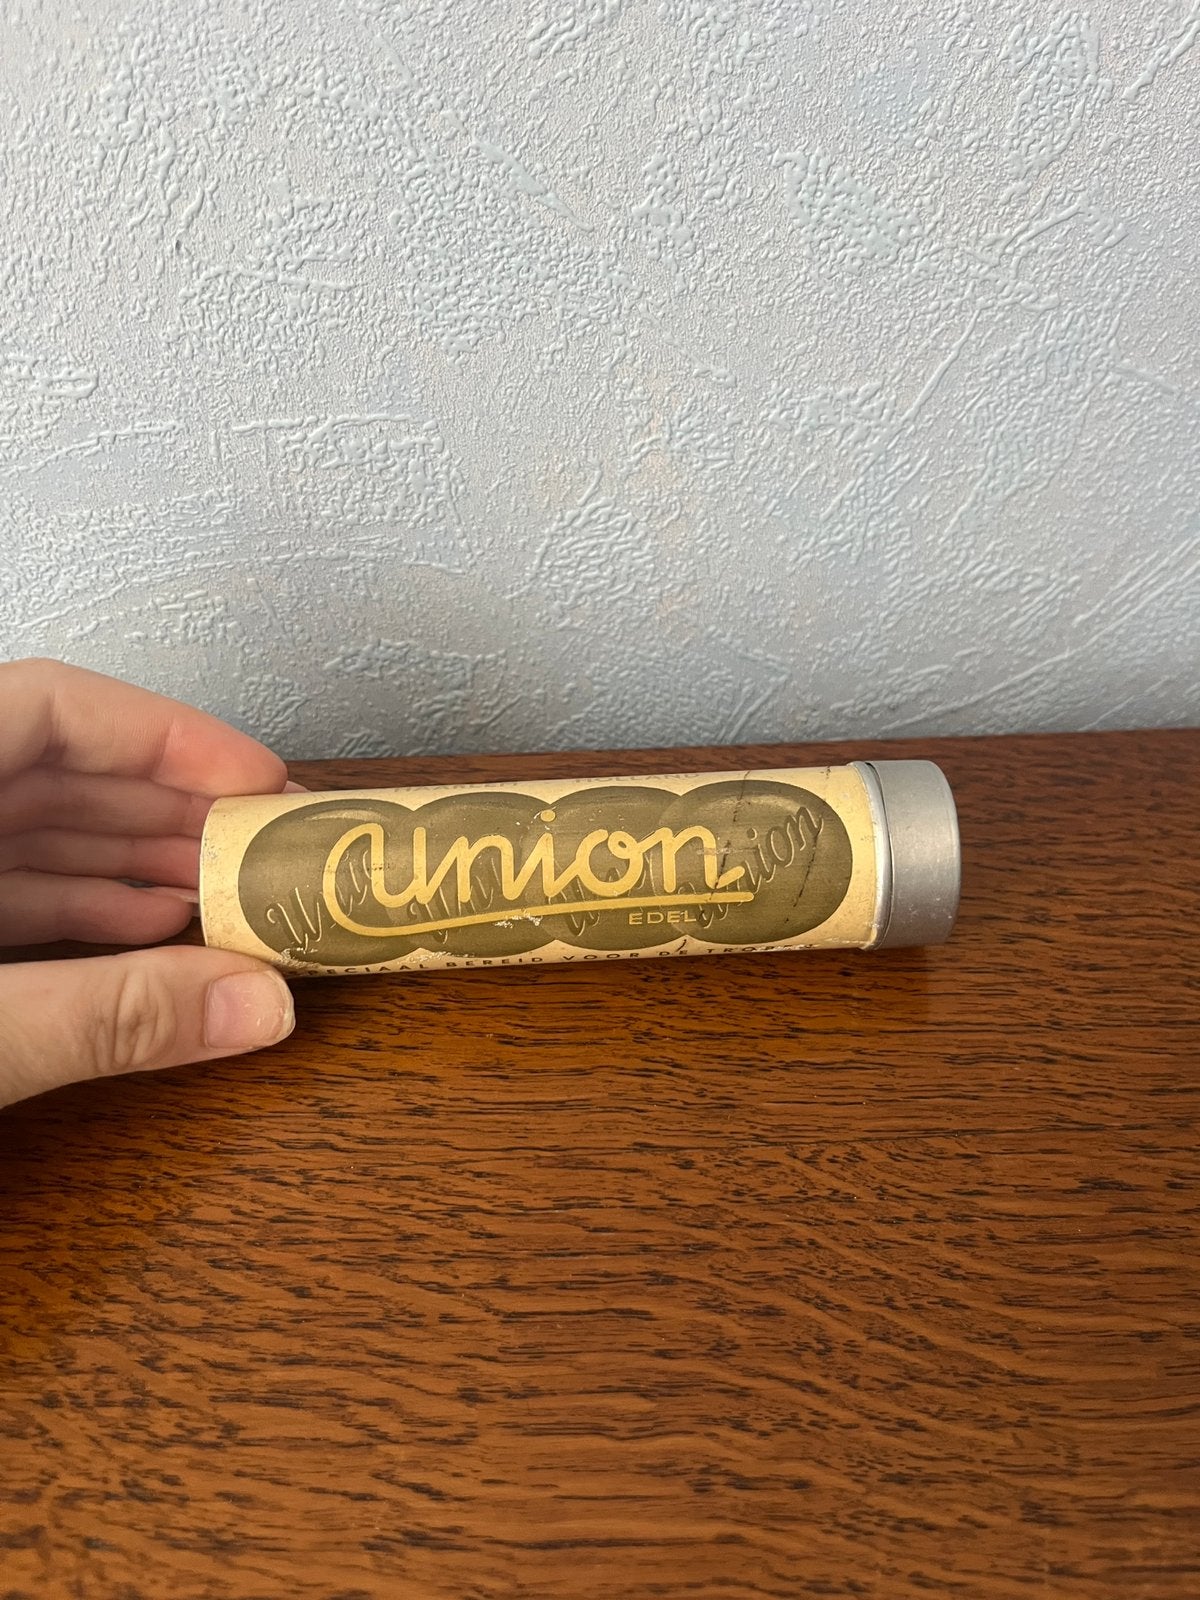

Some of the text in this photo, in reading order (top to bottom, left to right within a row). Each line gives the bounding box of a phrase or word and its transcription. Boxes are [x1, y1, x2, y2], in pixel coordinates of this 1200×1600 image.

[321, 808, 755, 937] Union
[628, 909, 697, 925] EDEL
[445, 957, 543, 968] BEREID
[562, 952, 640, 962] VOOR
